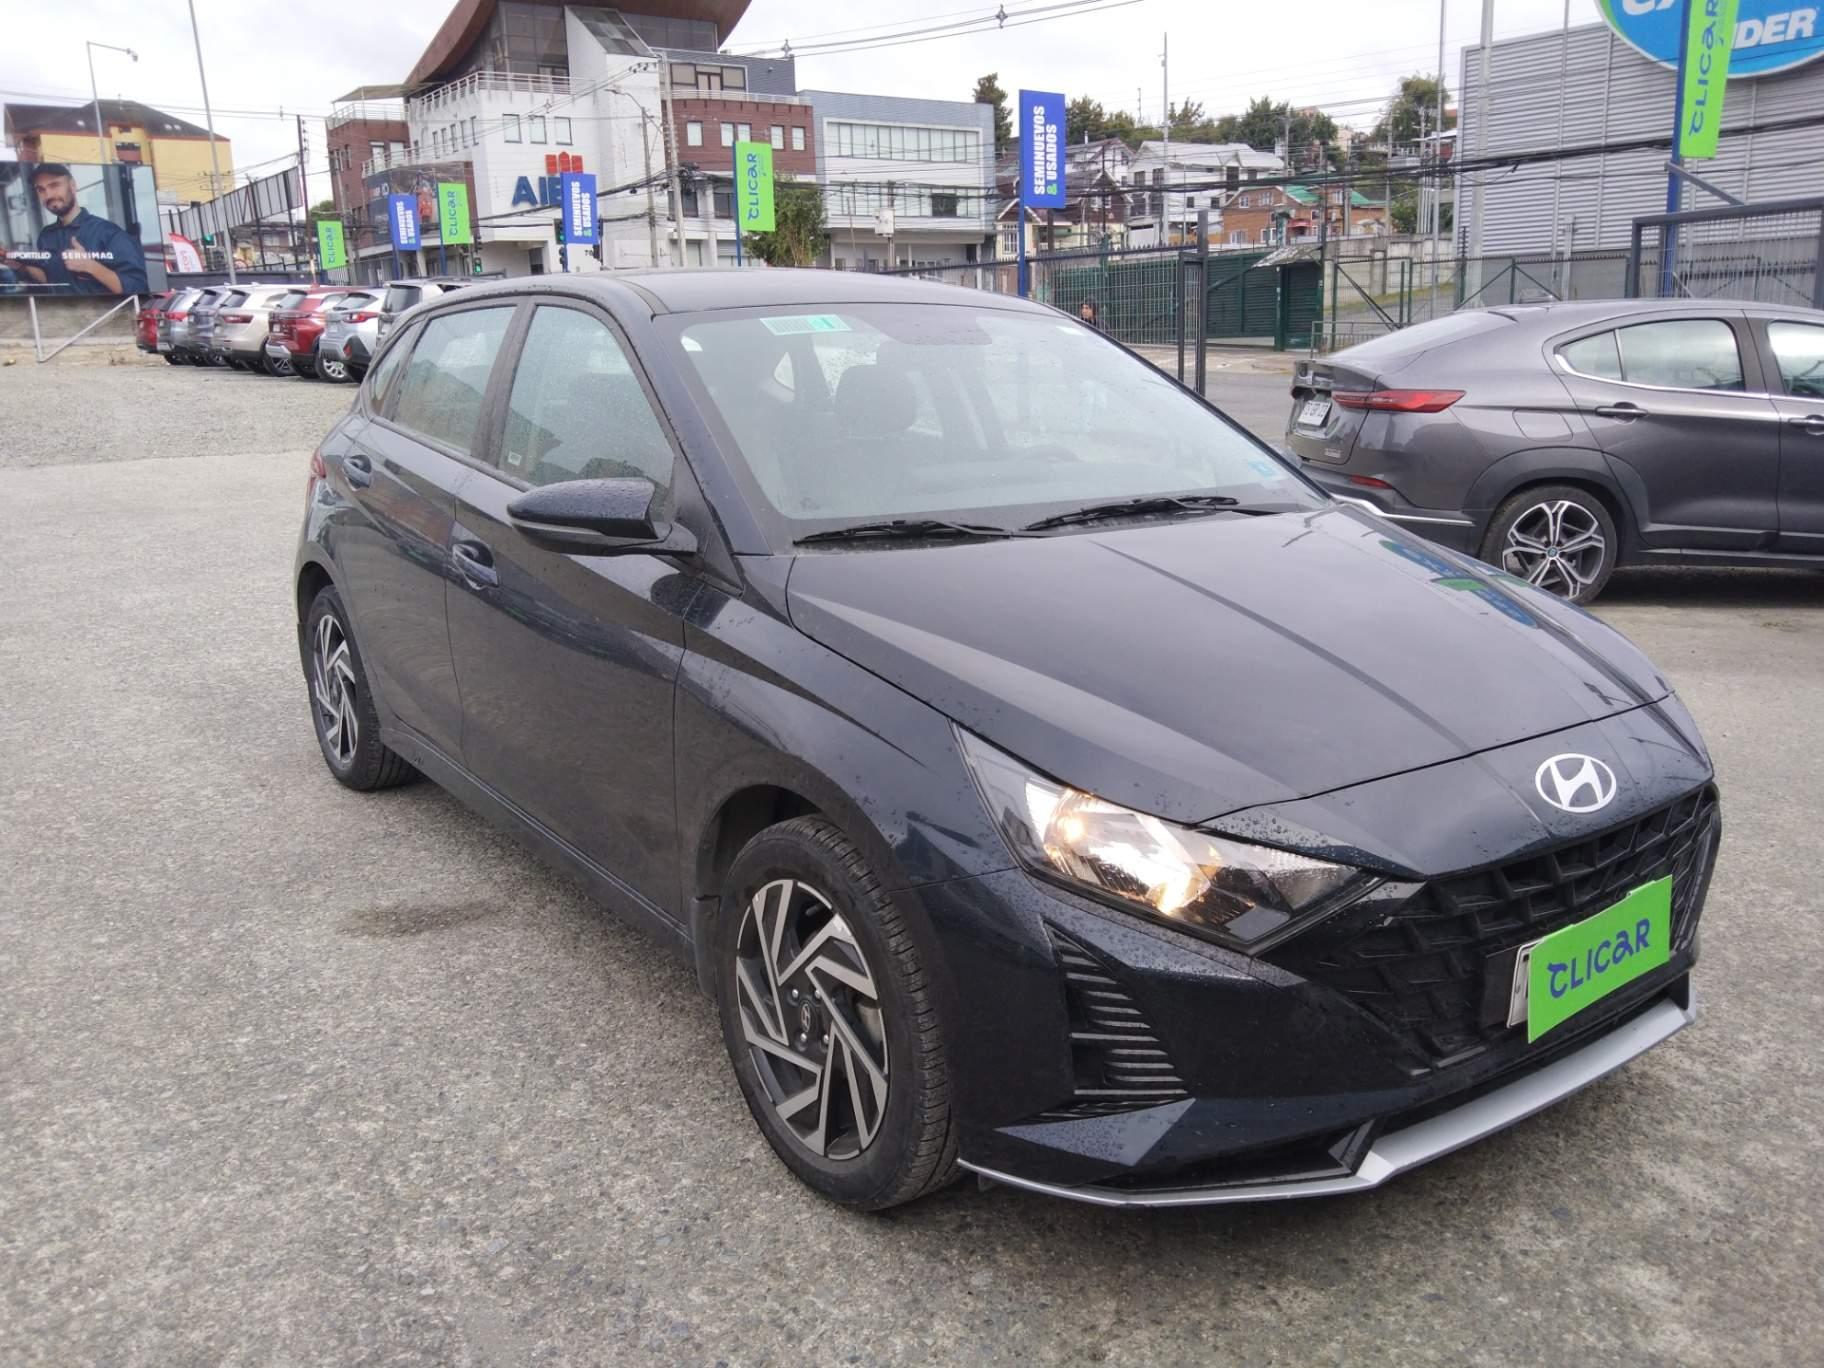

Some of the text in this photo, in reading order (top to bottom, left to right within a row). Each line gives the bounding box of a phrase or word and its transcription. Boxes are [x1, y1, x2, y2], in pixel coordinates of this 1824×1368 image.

[1033, 105, 1045, 195] SEMINUEVOS
[1046, 124, 1058, 196] & USADOS
[512, 175, 562, 207] AIE
[571, 181, 583, 237] SEMINUEVOS
[581, 192, 592, 227] USADOS
